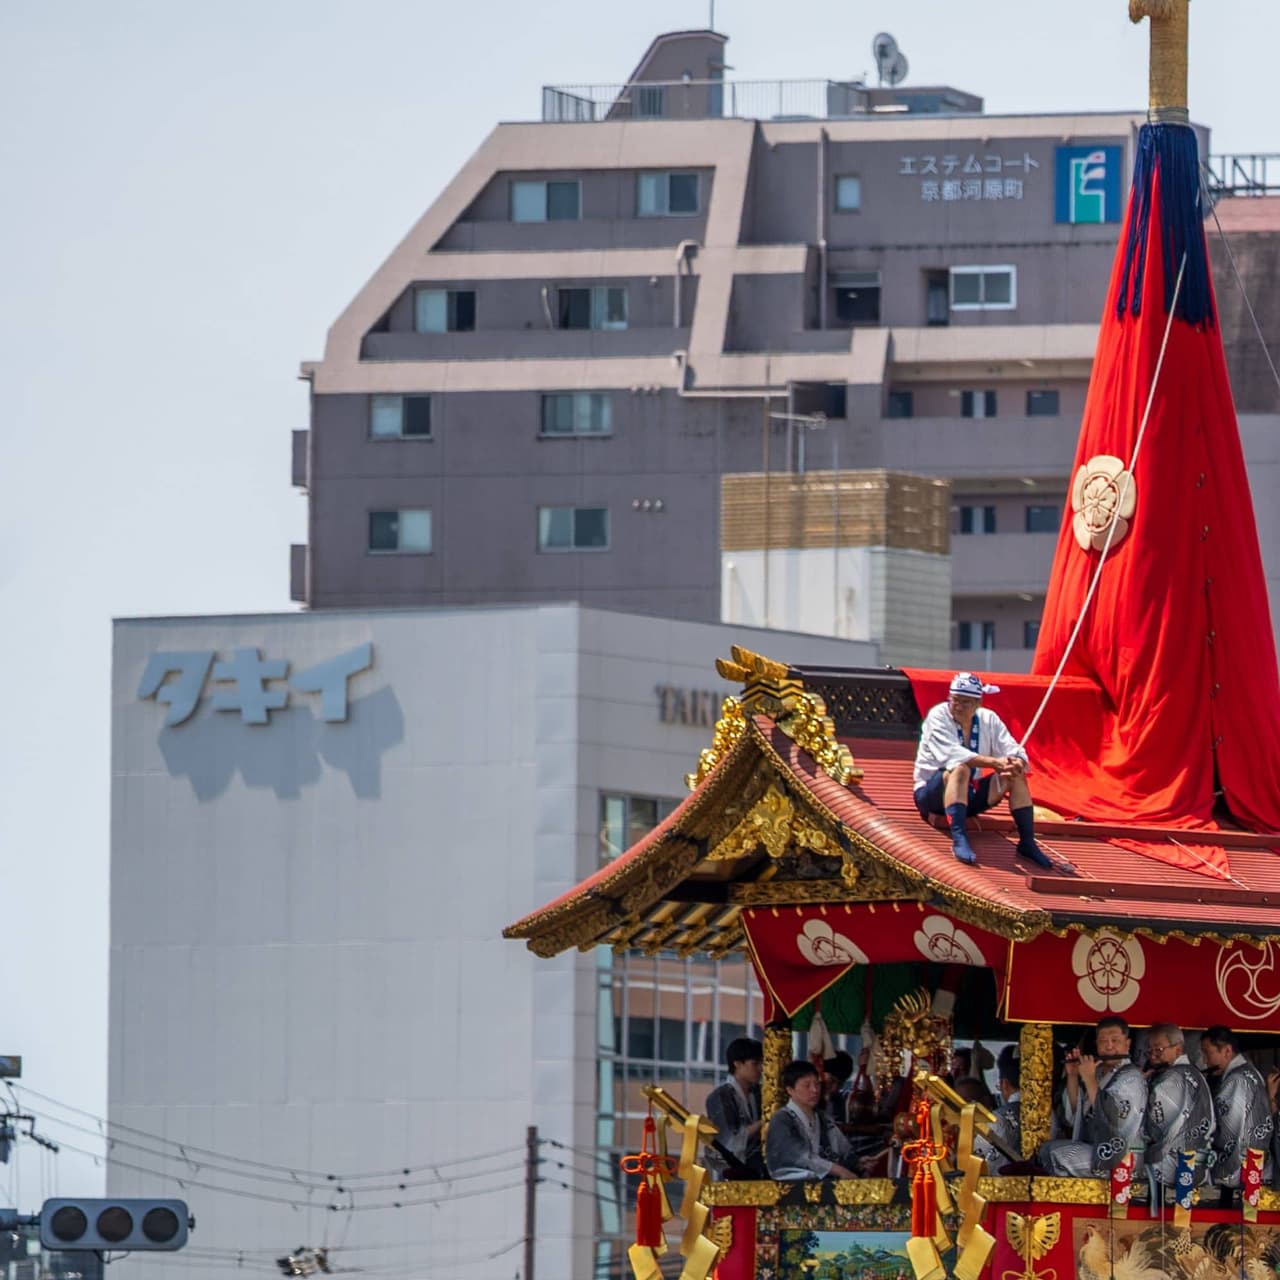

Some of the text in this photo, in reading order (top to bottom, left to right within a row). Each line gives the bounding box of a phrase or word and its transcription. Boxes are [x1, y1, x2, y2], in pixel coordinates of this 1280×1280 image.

[898, 152, 1041, 174] エステムコート
[920, 177, 1025, 201] 京都河原町
[137, 642, 375, 727] タキイ
